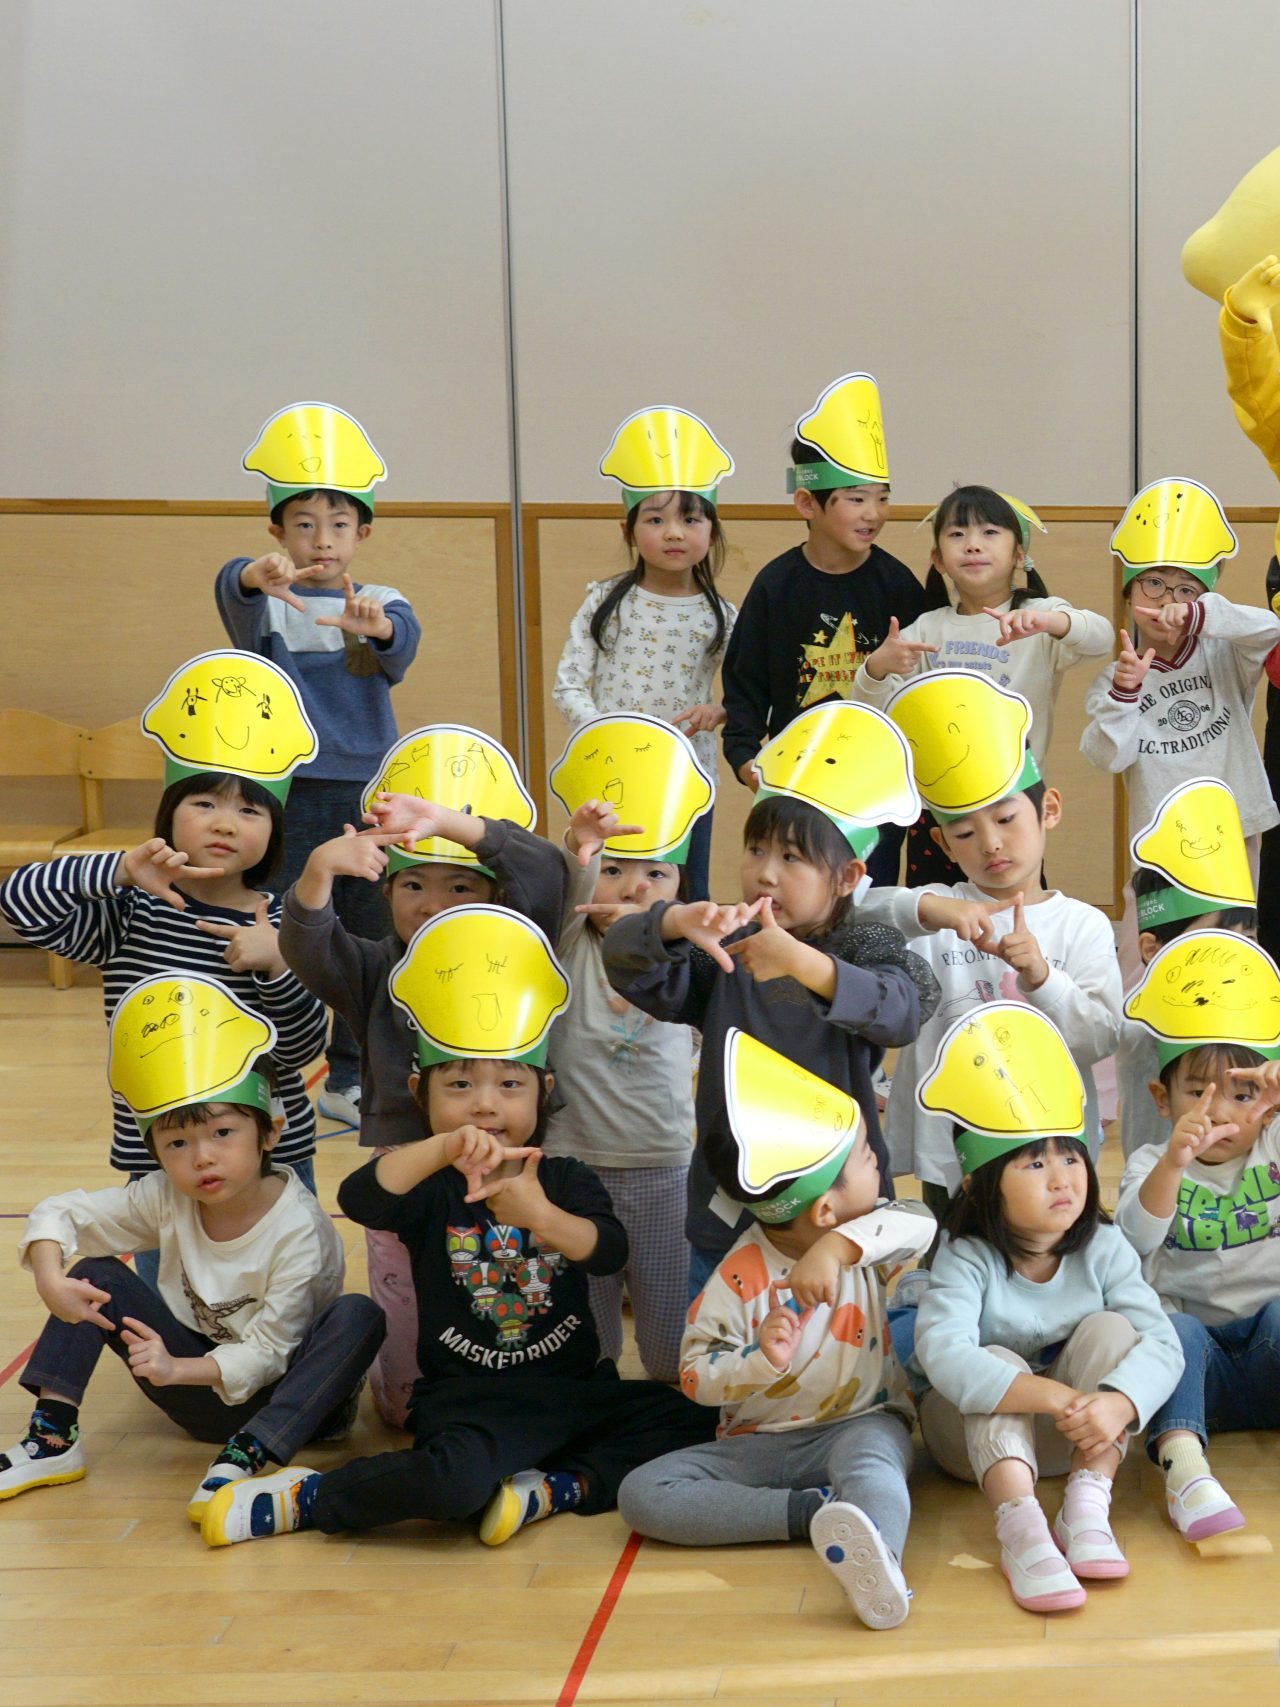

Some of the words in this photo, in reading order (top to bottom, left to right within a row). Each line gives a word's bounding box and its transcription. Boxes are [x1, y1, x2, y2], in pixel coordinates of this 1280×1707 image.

[944, 640, 1010, 664] FRIENDS
[1157, 717, 1168, 727] 20
[438, 1326, 524, 1370] MASKED
[526, 1314, 582, 1361] RIDER
